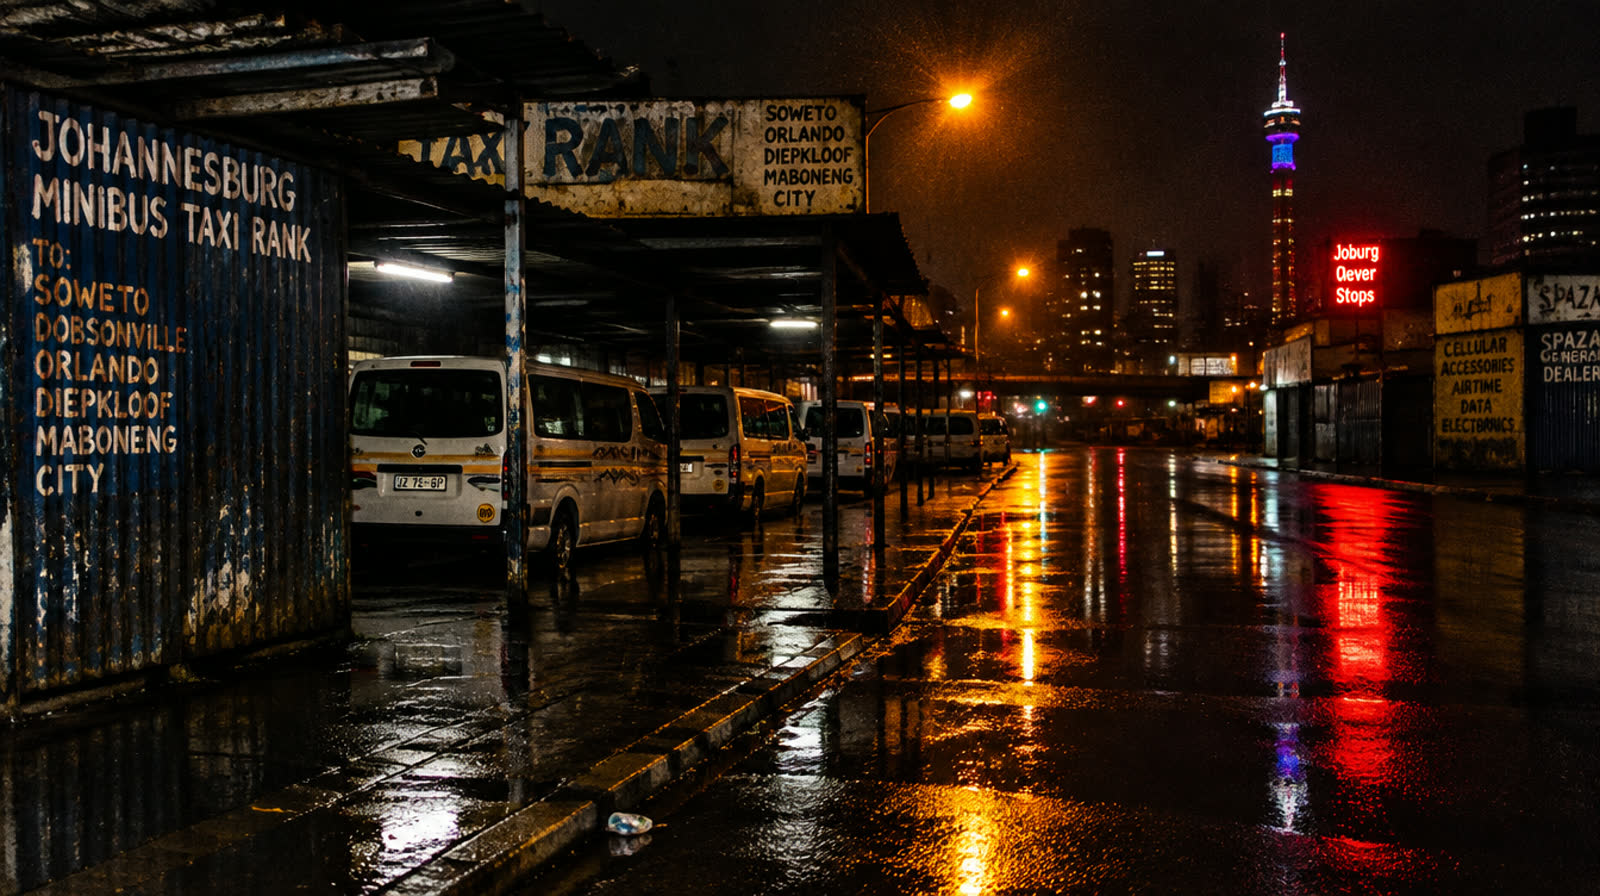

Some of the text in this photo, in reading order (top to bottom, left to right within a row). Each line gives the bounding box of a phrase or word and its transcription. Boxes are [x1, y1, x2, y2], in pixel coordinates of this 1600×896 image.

[766, 104, 837, 122] SOWETO
[765, 126, 845, 144] ORLANDO
[543, 116, 730, 180] RANK
[764, 147, 854, 165] DIEPKLOOF
[32, 110, 297, 212] JOHANNESBURG
[764, 168, 853, 186] MABONENG
[773, 189, 815, 207] CITY
[31, 173, 312, 263] MINIBUS TAXI RANK
[32, 237, 72, 270] TO:
[1333, 243, 1379, 263] Joburg
[34, 273, 150, 316] SOWETO
[1336, 286, 1375, 307] Stops
[35, 311, 188, 353] DOBSONVILLE
[1540, 330, 1600, 351] SPAZA
[1444, 337, 1507, 357] CELLULAR
[35, 349, 159, 385] ORLANDO
[1441, 358, 1515, 376] ACCESSORIES
[1543, 365, 1600, 383] DEALER
[1452, 378, 1503, 395] AIRTIME
[35, 387, 172, 418] DIEPKLOOF
[1460, 398, 1492, 414] DATA
[35, 424, 177, 456] MABONENG
[35, 462, 104, 496] CITY
